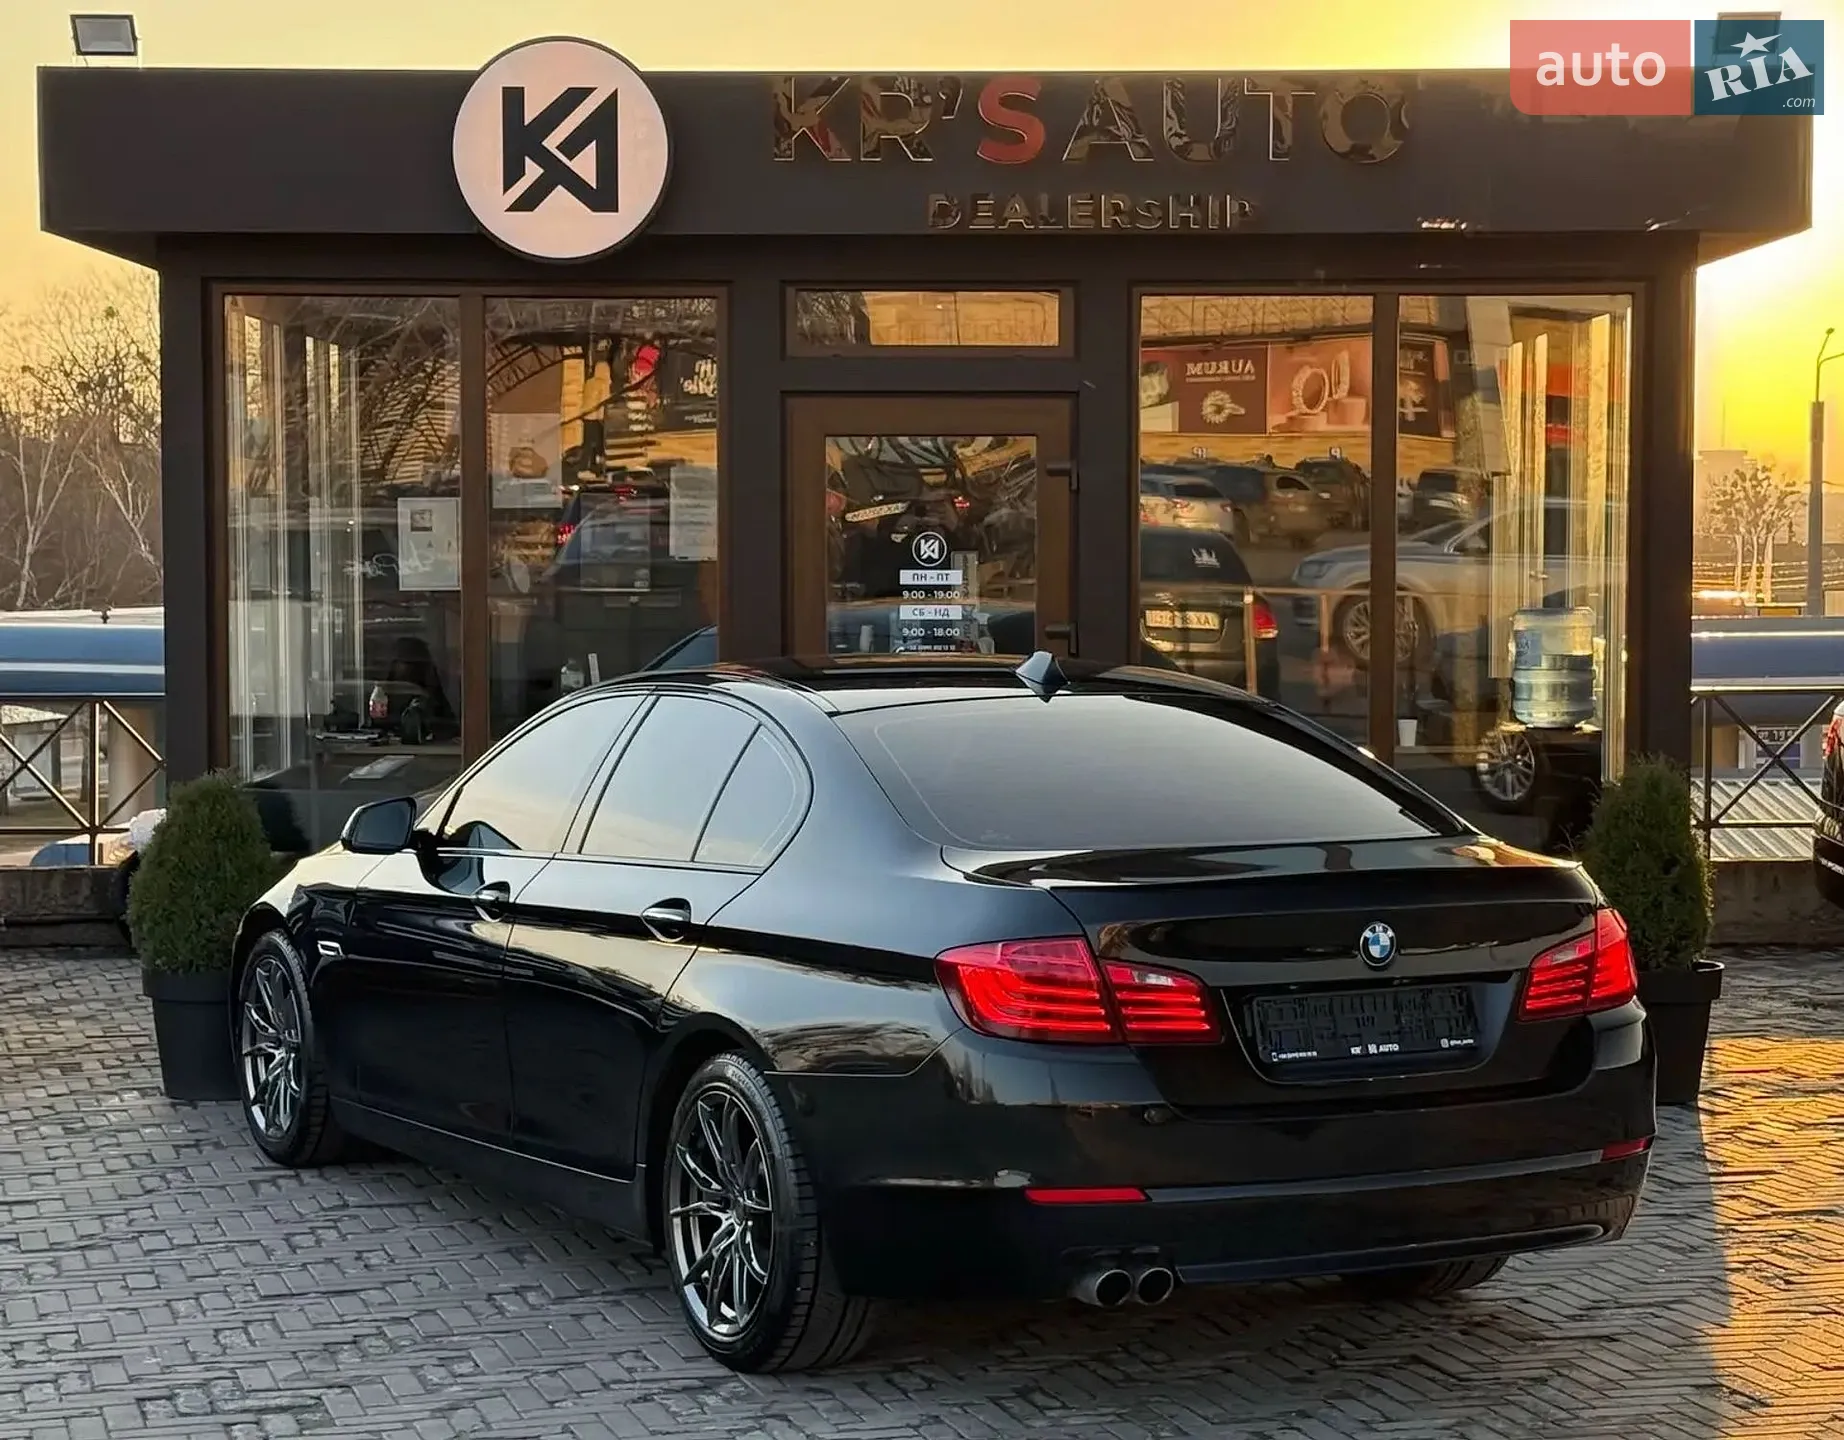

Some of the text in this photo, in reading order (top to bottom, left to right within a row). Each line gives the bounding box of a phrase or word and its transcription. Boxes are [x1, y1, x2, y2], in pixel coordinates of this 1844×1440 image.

[1062, 76, 1409, 164] AUTO
[928, 192, 1255, 230] DEALERSHIP
[912, 573, 928, 582] ПН
[937, 573, 950, 582] ПТ
[912, 608, 925, 617] СБ
[934, 608, 950, 618] НД
